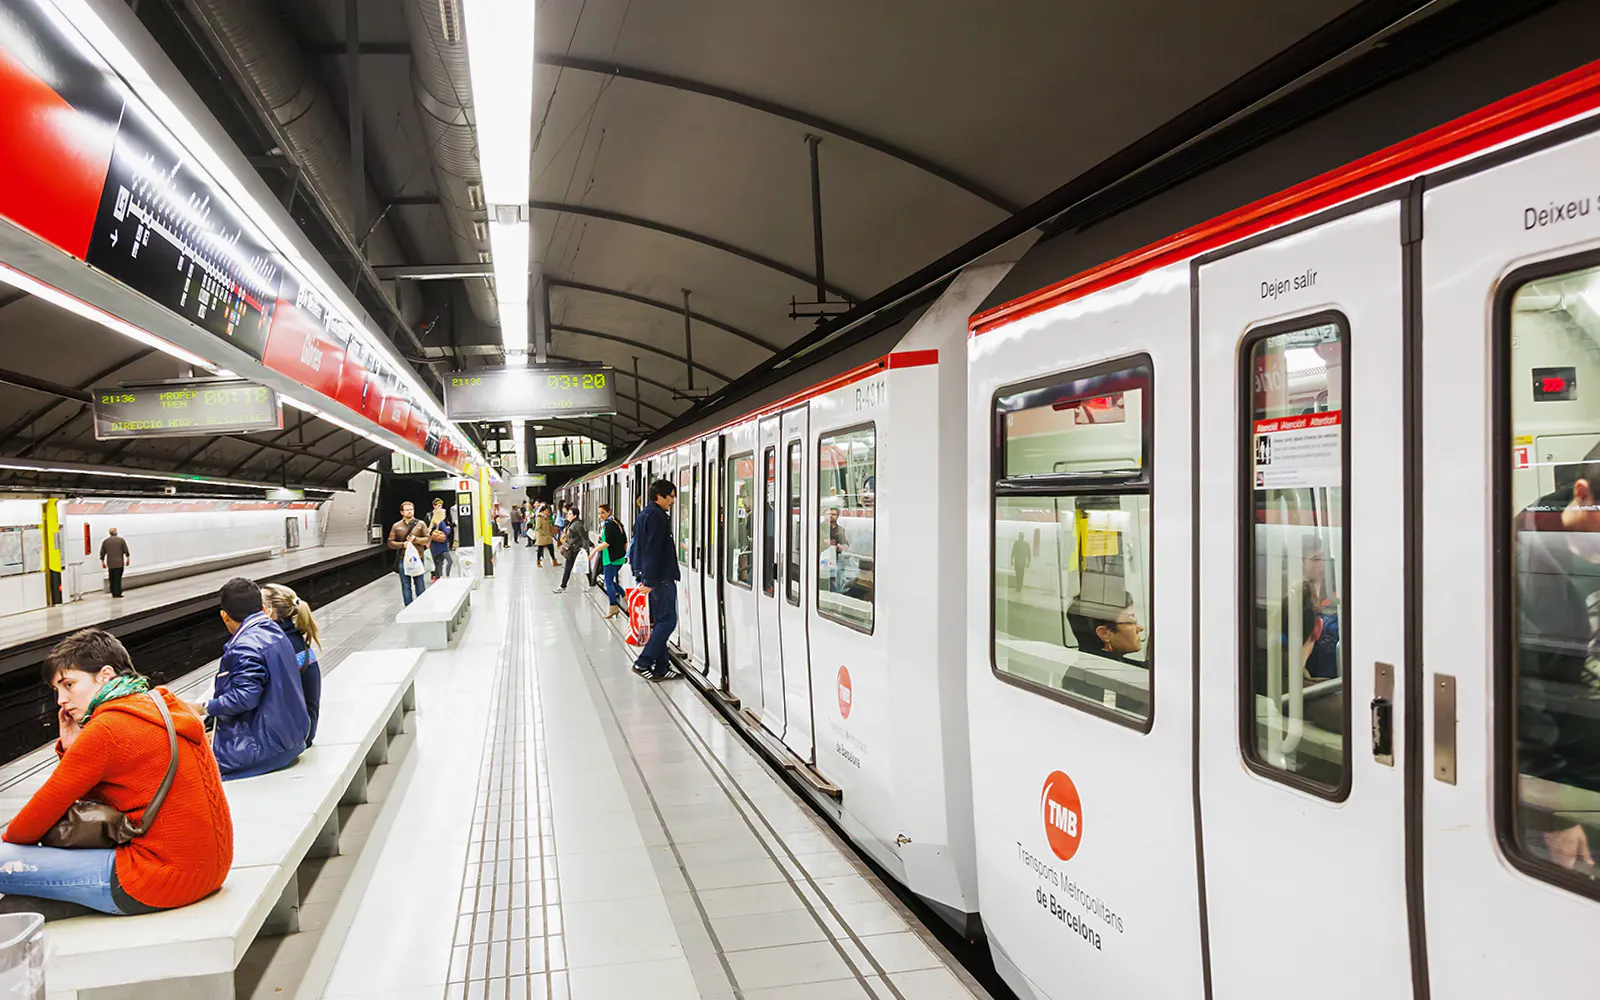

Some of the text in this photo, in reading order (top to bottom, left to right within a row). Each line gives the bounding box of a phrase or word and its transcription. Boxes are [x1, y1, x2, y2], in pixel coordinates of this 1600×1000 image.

[1524, 198, 1590, 231] Deixeu
[1261, 269, 1318, 299] Dejen salir
[160, 390, 198, 401] PROPER
[452, 377, 482, 387] 21:36
[548, 373, 605, 390] 03:20
[855, 380, 885, 411] R-4311
[102, 394, 135, 405] 21:36
[1048, 799, 1078, 838] TMB
[1017, 841, 1124, 934] Transports Metropolitans
[1036, 886, 1102, 951] de Barcelona
